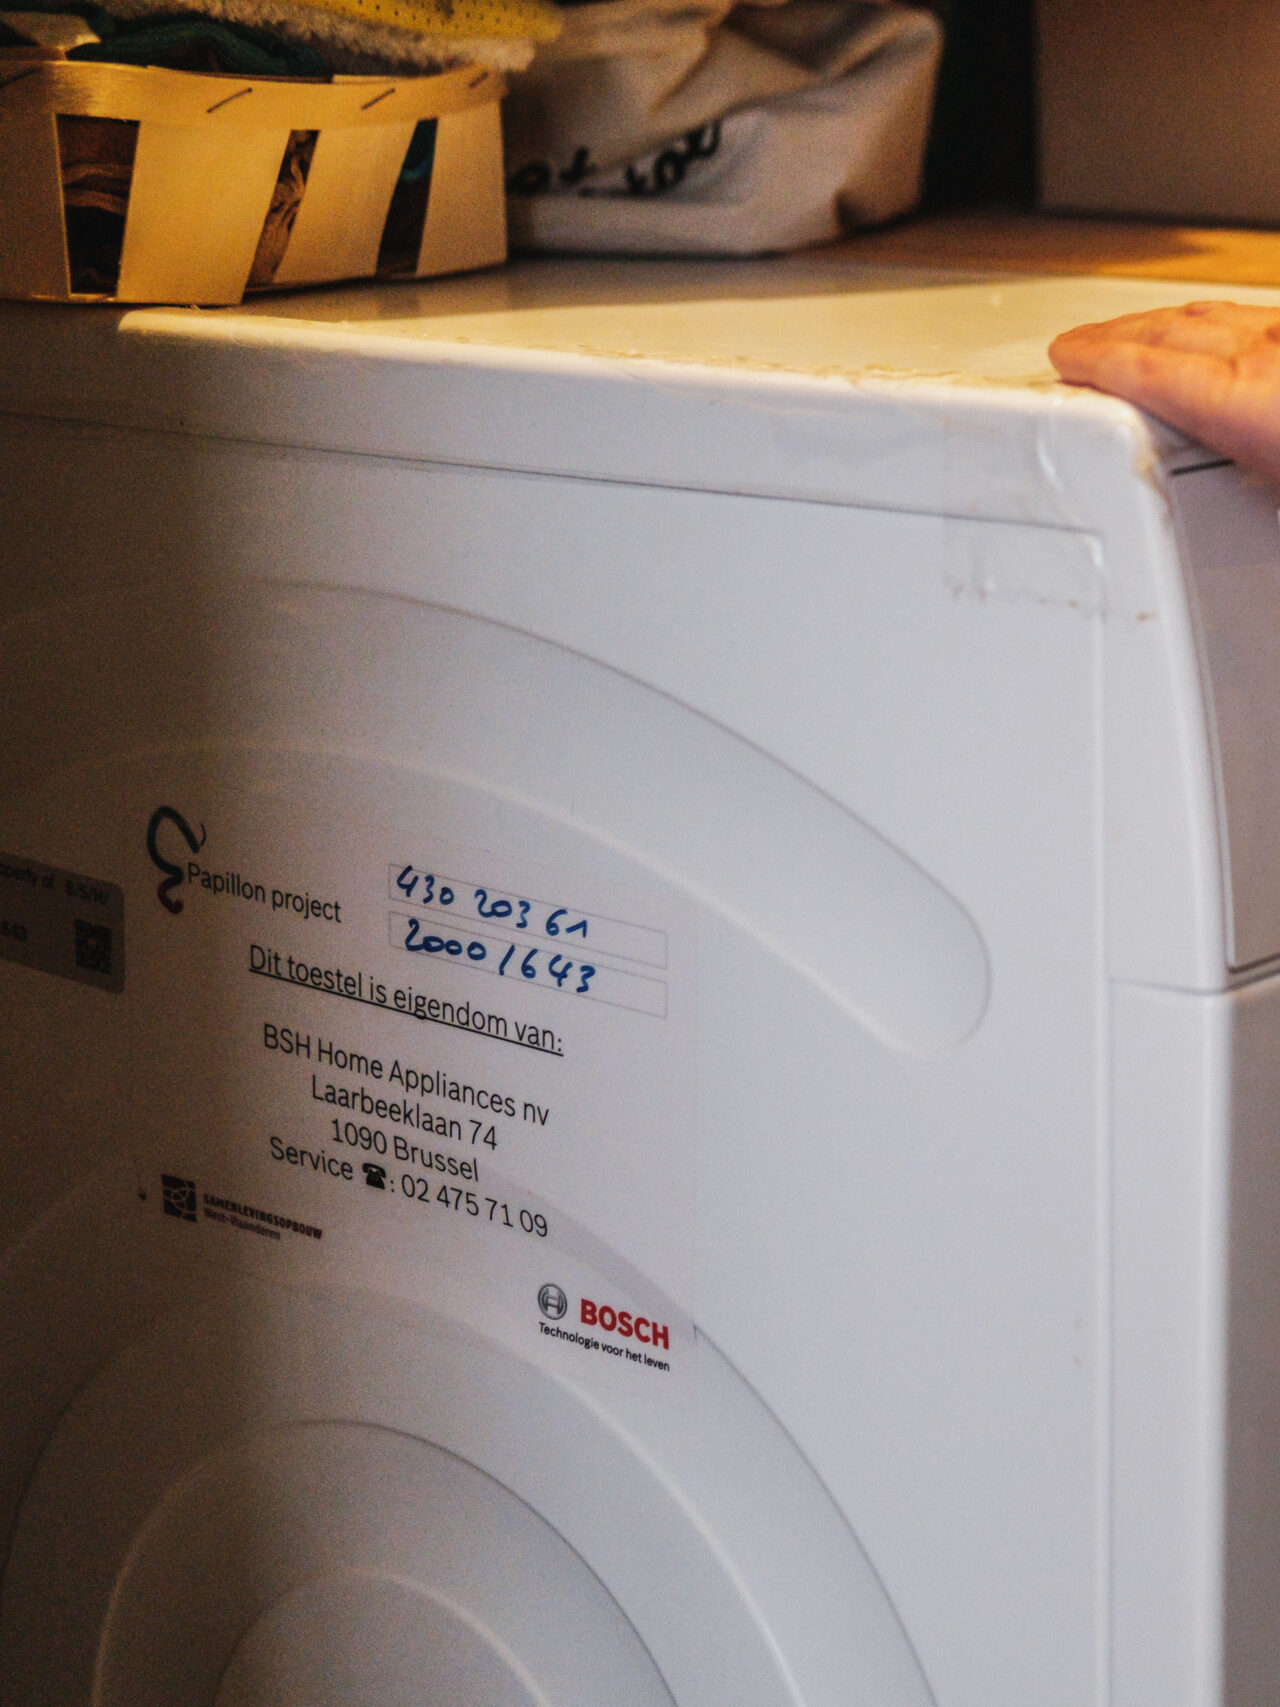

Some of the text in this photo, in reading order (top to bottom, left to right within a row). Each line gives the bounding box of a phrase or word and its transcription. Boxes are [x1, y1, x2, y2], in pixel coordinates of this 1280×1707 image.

[188, 862, 342, 923] Papillon project
[396, 865, 455, 905] 430
[474, 889, 531, 929] 203
[250, 944, 563, 1053] Dit toestel is eigendom van:
[263, 1023, 550, 1127] BSH Home Appliances nv
[311, 1074, 498, 1150] Laarbeeklaan 74
[330, 1118, 479, 1183] 1090 Brussel
[203, 1193, 323, 1240] SAMENLEVINGSOPBOUW
[269, 1136, 548, 1238] Service 02 475 71 09
[538, 1321, 670, 1373] Technologie voor het leven
[580, 1298, 670, 1351] BOSCH
